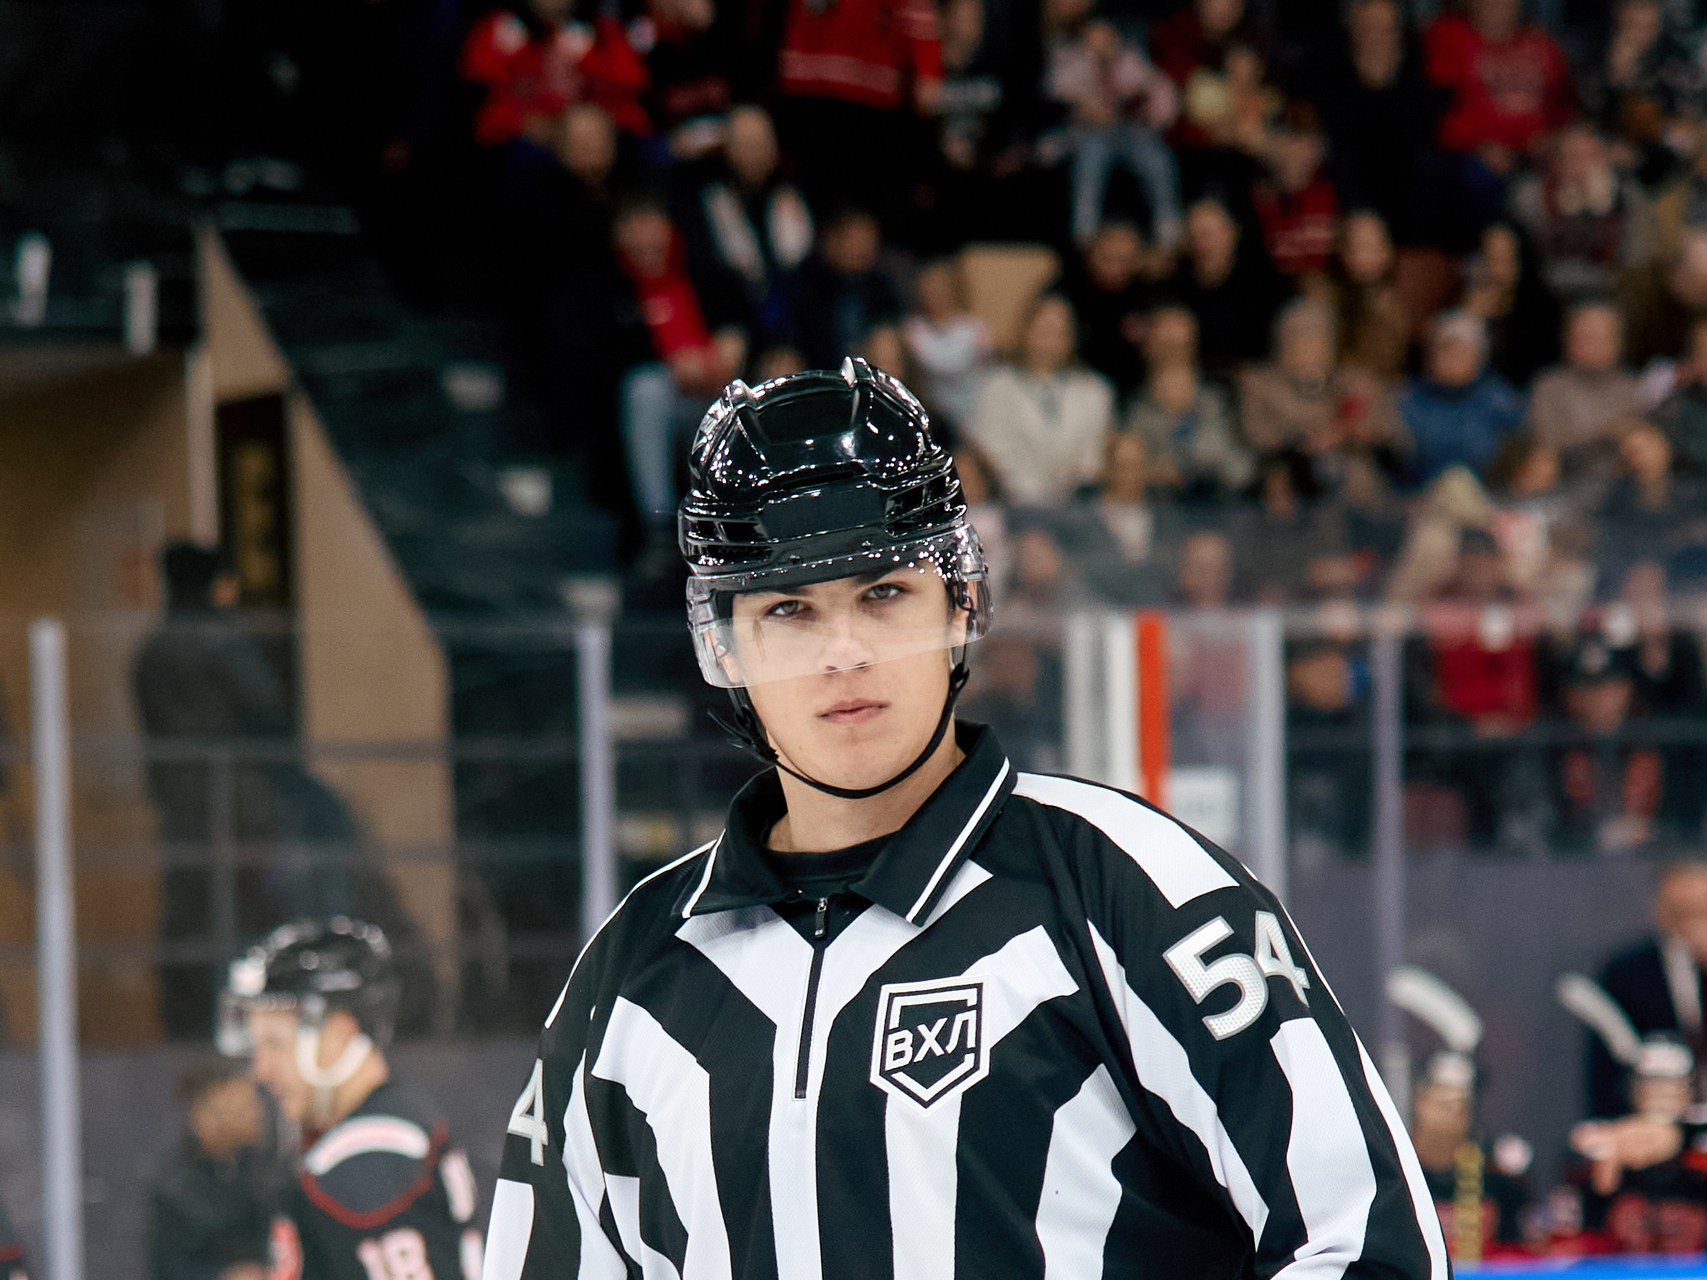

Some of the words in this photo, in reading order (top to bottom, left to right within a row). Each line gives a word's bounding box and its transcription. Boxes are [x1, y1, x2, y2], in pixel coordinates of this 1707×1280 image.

[1161, 909, 1311, 1041] 54
[885, 1008, 977, 1072] ВХЛ
[507, 1057, 549, 1167] 4
